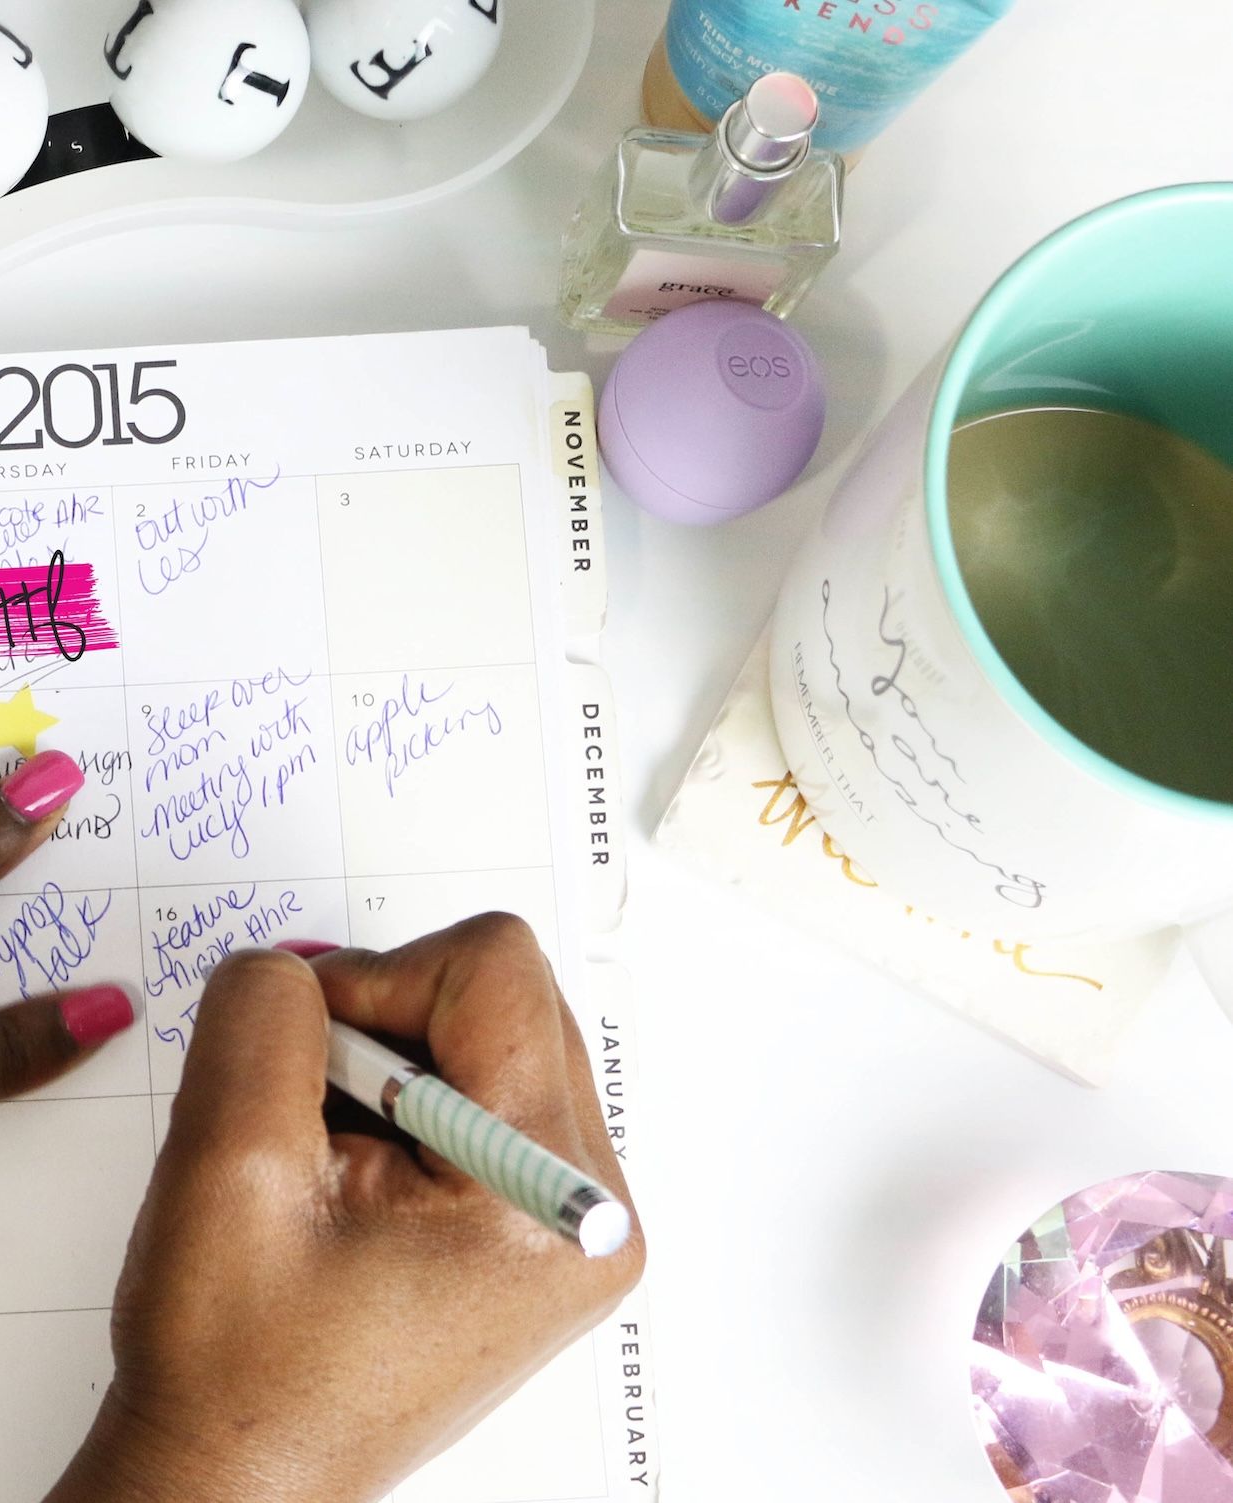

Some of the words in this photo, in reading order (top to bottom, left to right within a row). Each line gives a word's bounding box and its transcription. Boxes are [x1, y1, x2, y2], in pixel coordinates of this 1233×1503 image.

[698, 10, 743, 56] TRIPLE
[728, 355, 790, 378] eos
[353, 440, 473, 460] SATURDAY
[171, 453, 251, 470] FRIDAY
[339, 493, 350, 507] 3
[563, 411, 592, 573] NOVEMBER
[136, 503, 146, 517] 2
[351, 692, 375, 707] 10
[141, 704, 152, 718] 9
[581, 703, 610, 866] DECEMBER
[364, 896, 386, 911] 17
[155, 906, 178, 922] 16
[601, 1015, 627, 1161] JANUARY
[620, 1321, 649, 1488] FEBRUARY
